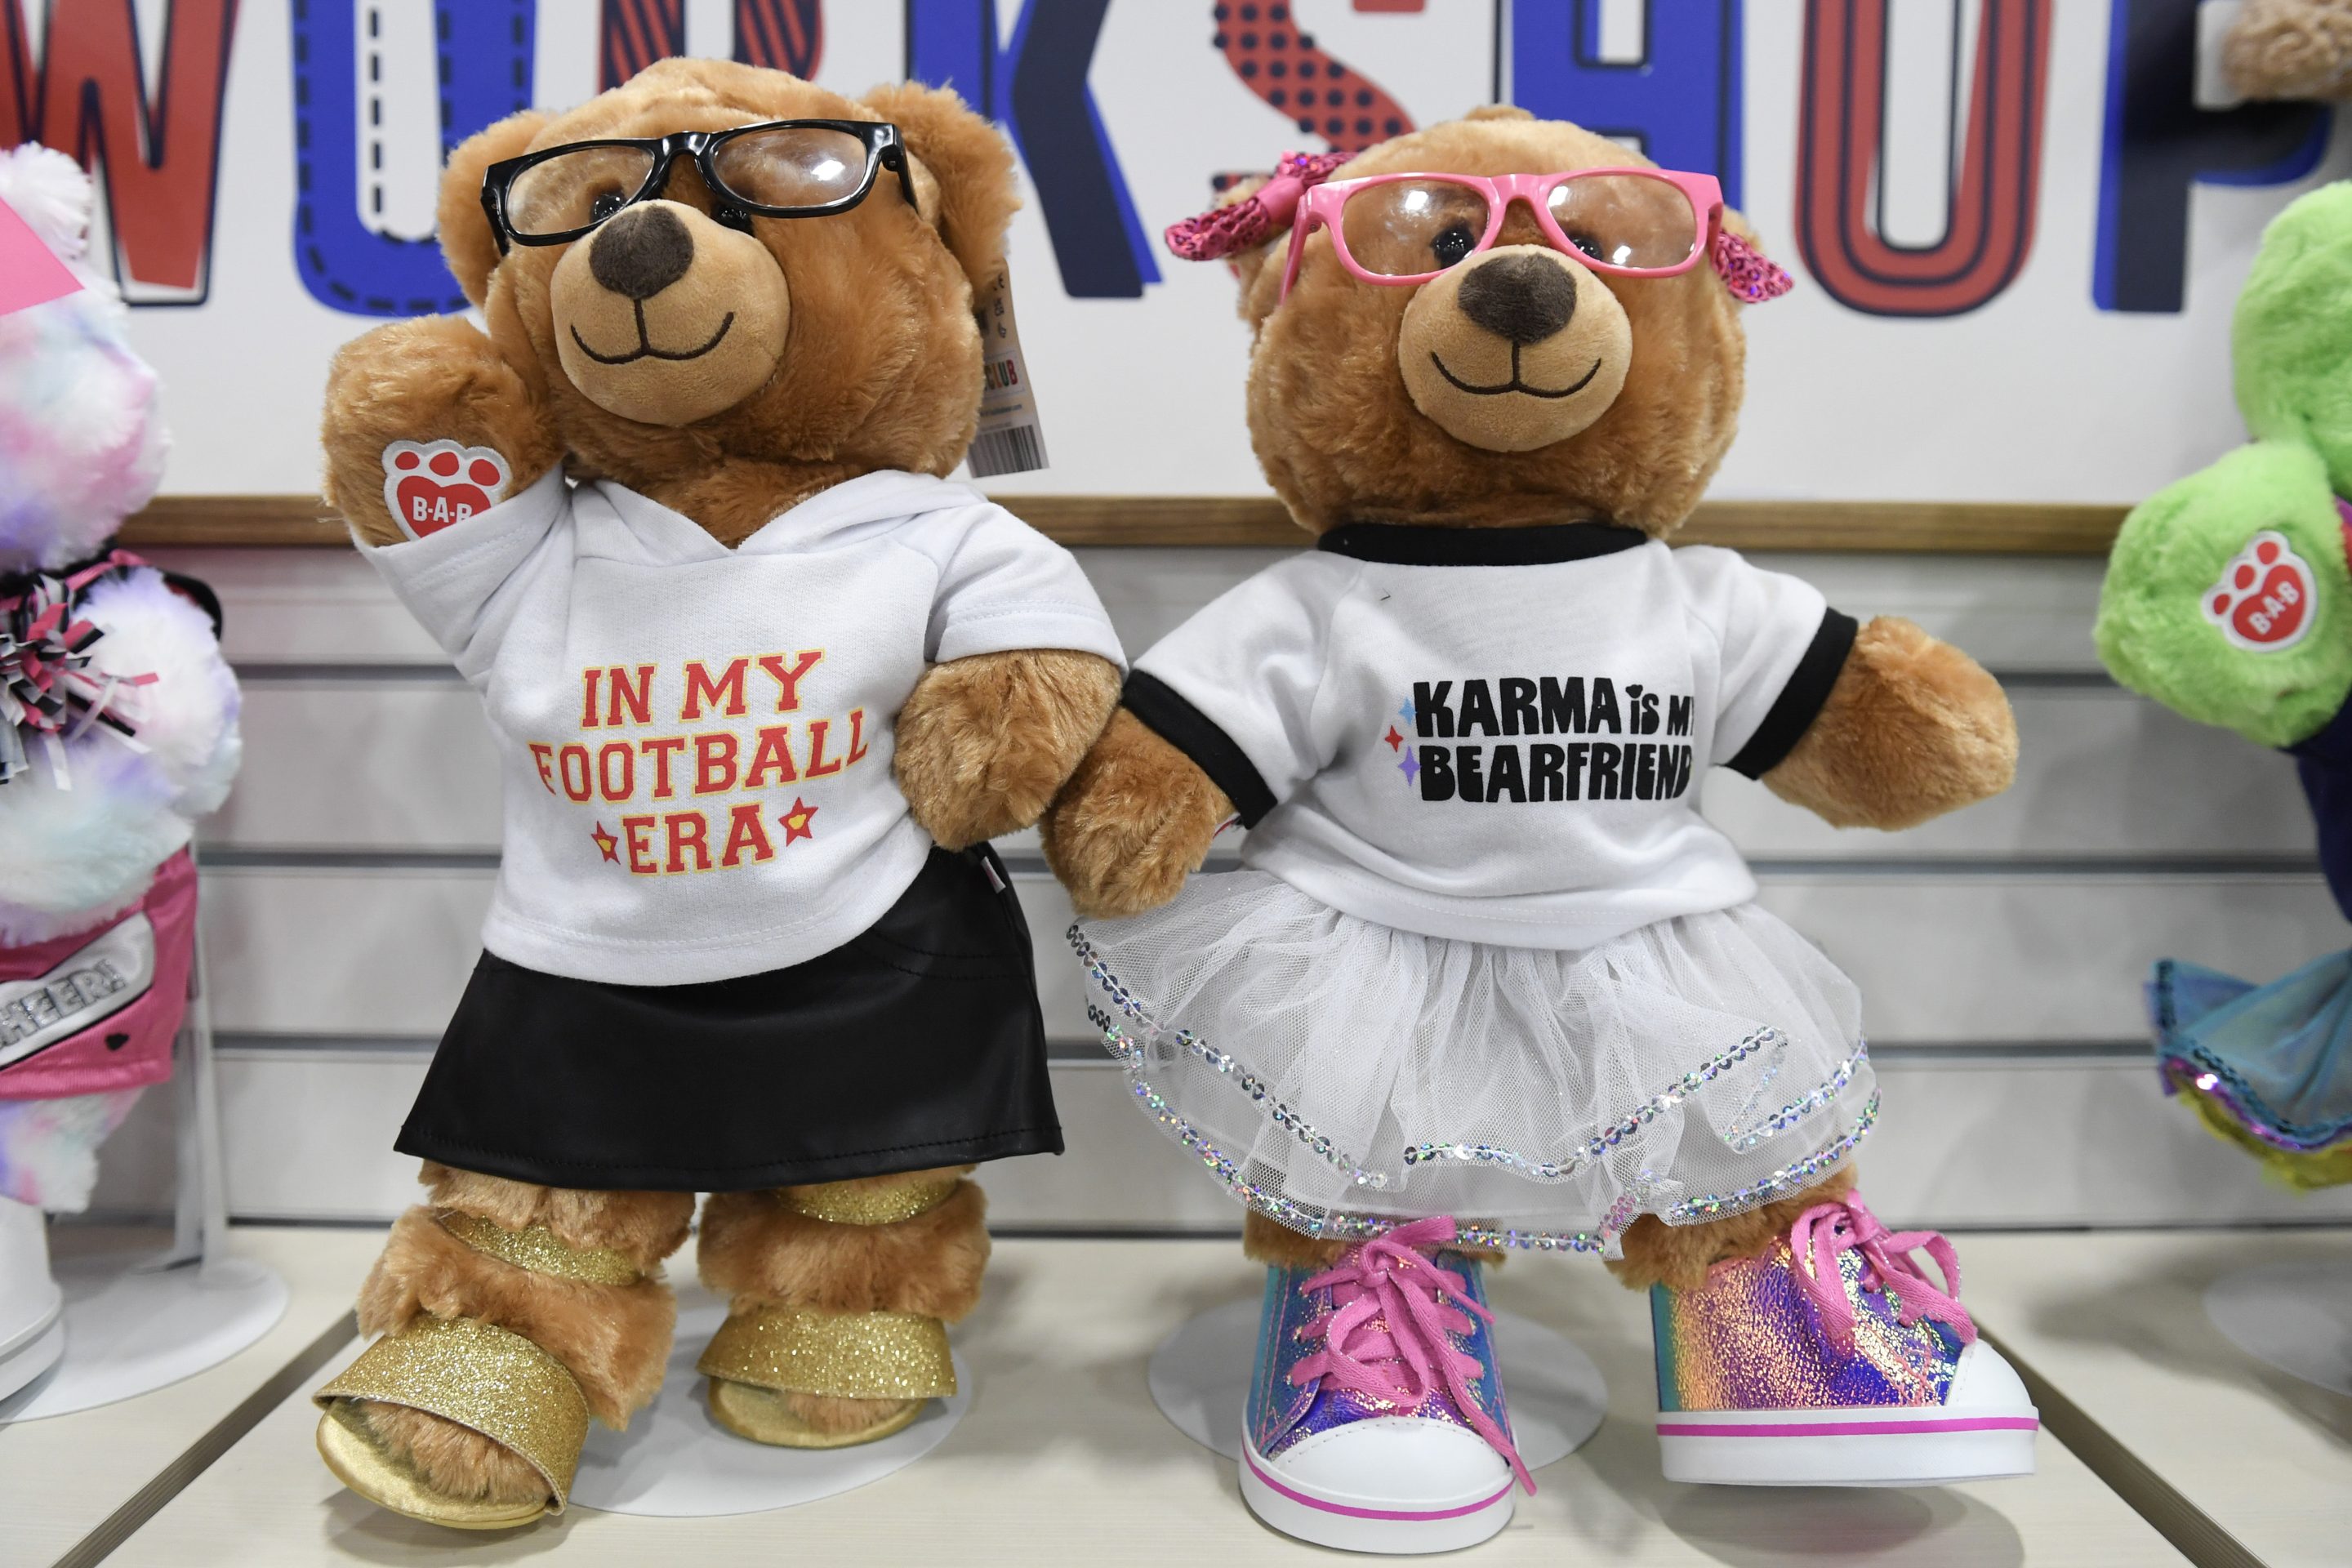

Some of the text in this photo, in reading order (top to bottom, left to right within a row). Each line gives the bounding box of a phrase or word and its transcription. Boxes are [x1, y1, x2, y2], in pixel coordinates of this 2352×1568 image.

[581, 648, 825, 730] IN MY
[1414, 676, 1622, 738] KARMA
[1667, 694, 1695, 737] M
[528, 706, 869, 804] FOOTBALL
[1419, 742, 1693, 804] BEARFRIEND
[621, 802, 776, 877] ERA
[0, 959, 127, 1049] HEER!
